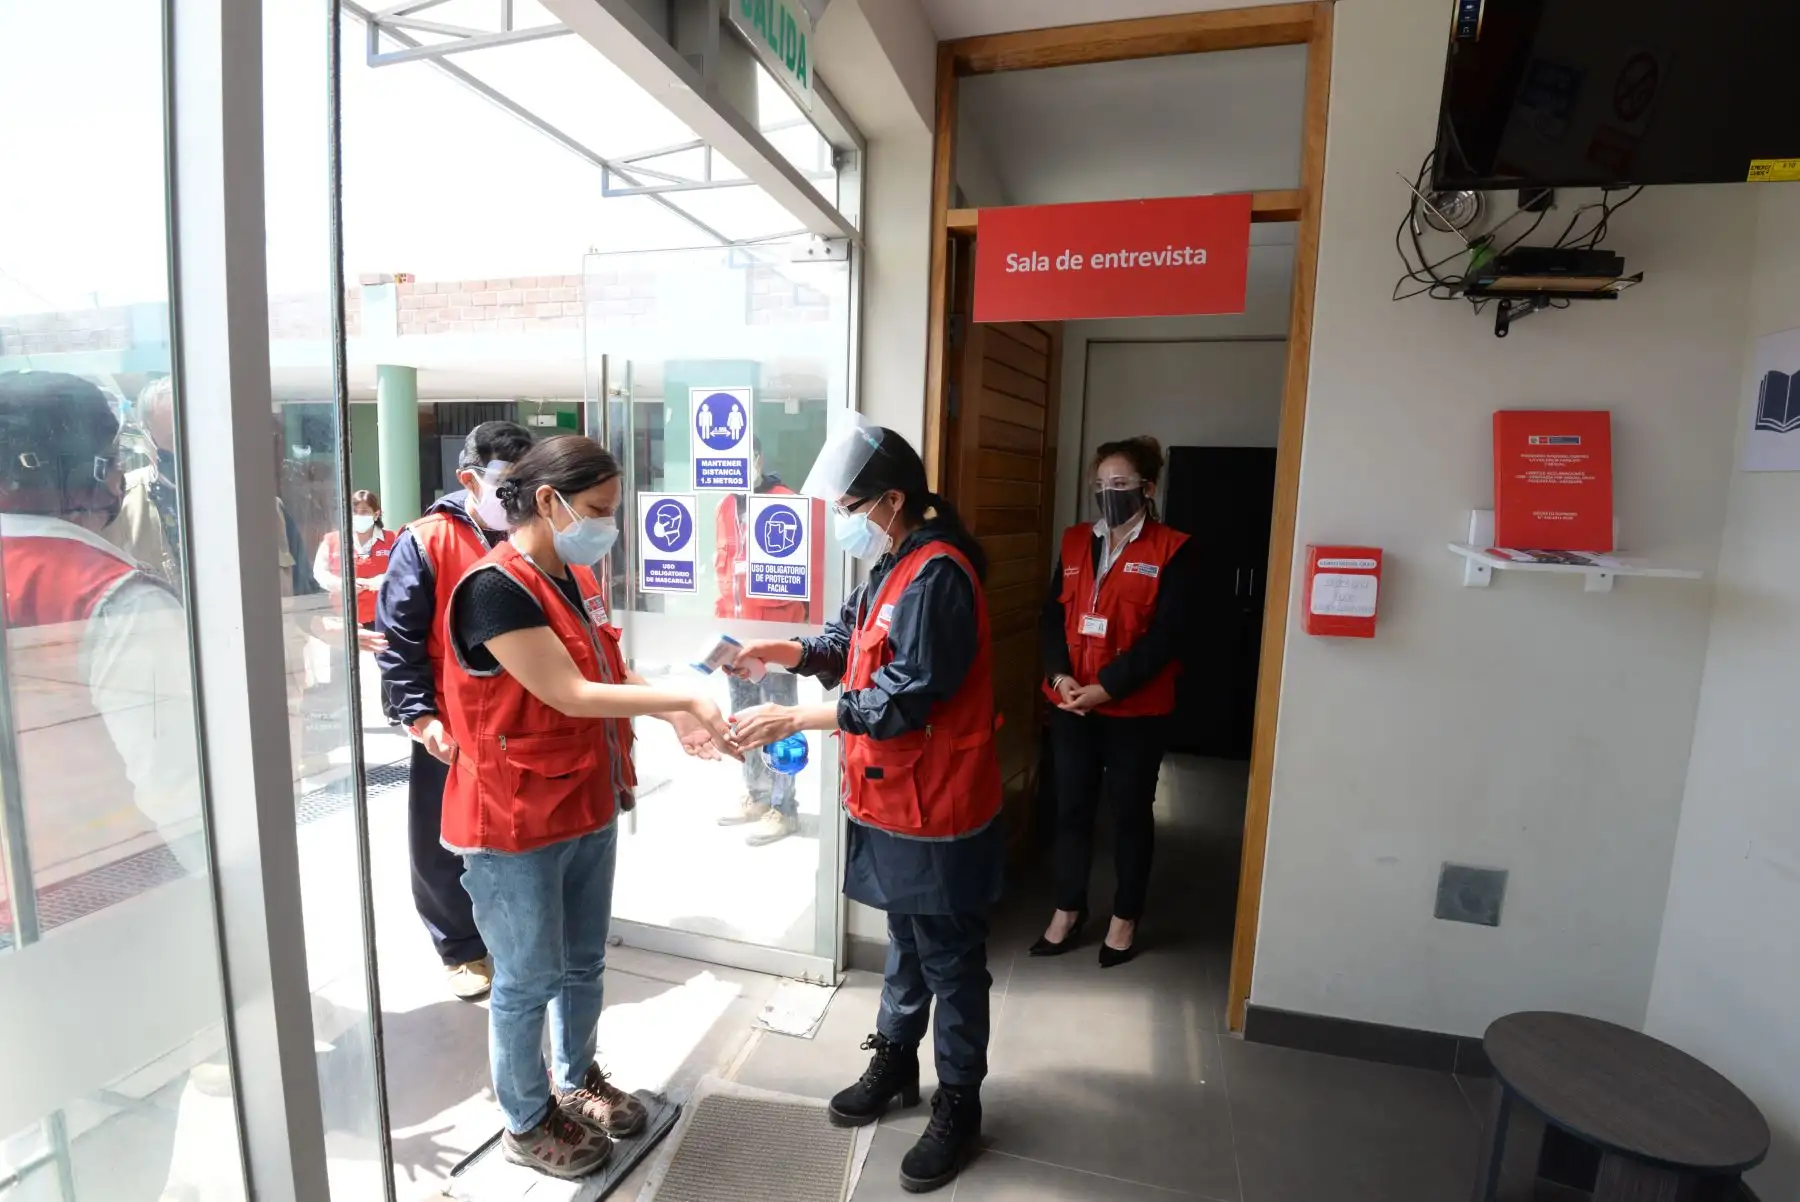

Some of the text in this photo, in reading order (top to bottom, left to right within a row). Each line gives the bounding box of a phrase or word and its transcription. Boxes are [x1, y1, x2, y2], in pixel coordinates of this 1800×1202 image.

[1005, 245, 1207, 273] Sala de entrevista
[712, 477, 743, 485] METROS
[751, 563, 806, 576] USO OBLIGATORIO
[655, 577, 693, 585] MASCARILLA
[756, 573, 801, 585] DE PROTECTOR
[767, 583, 789, 593] FACIAL
